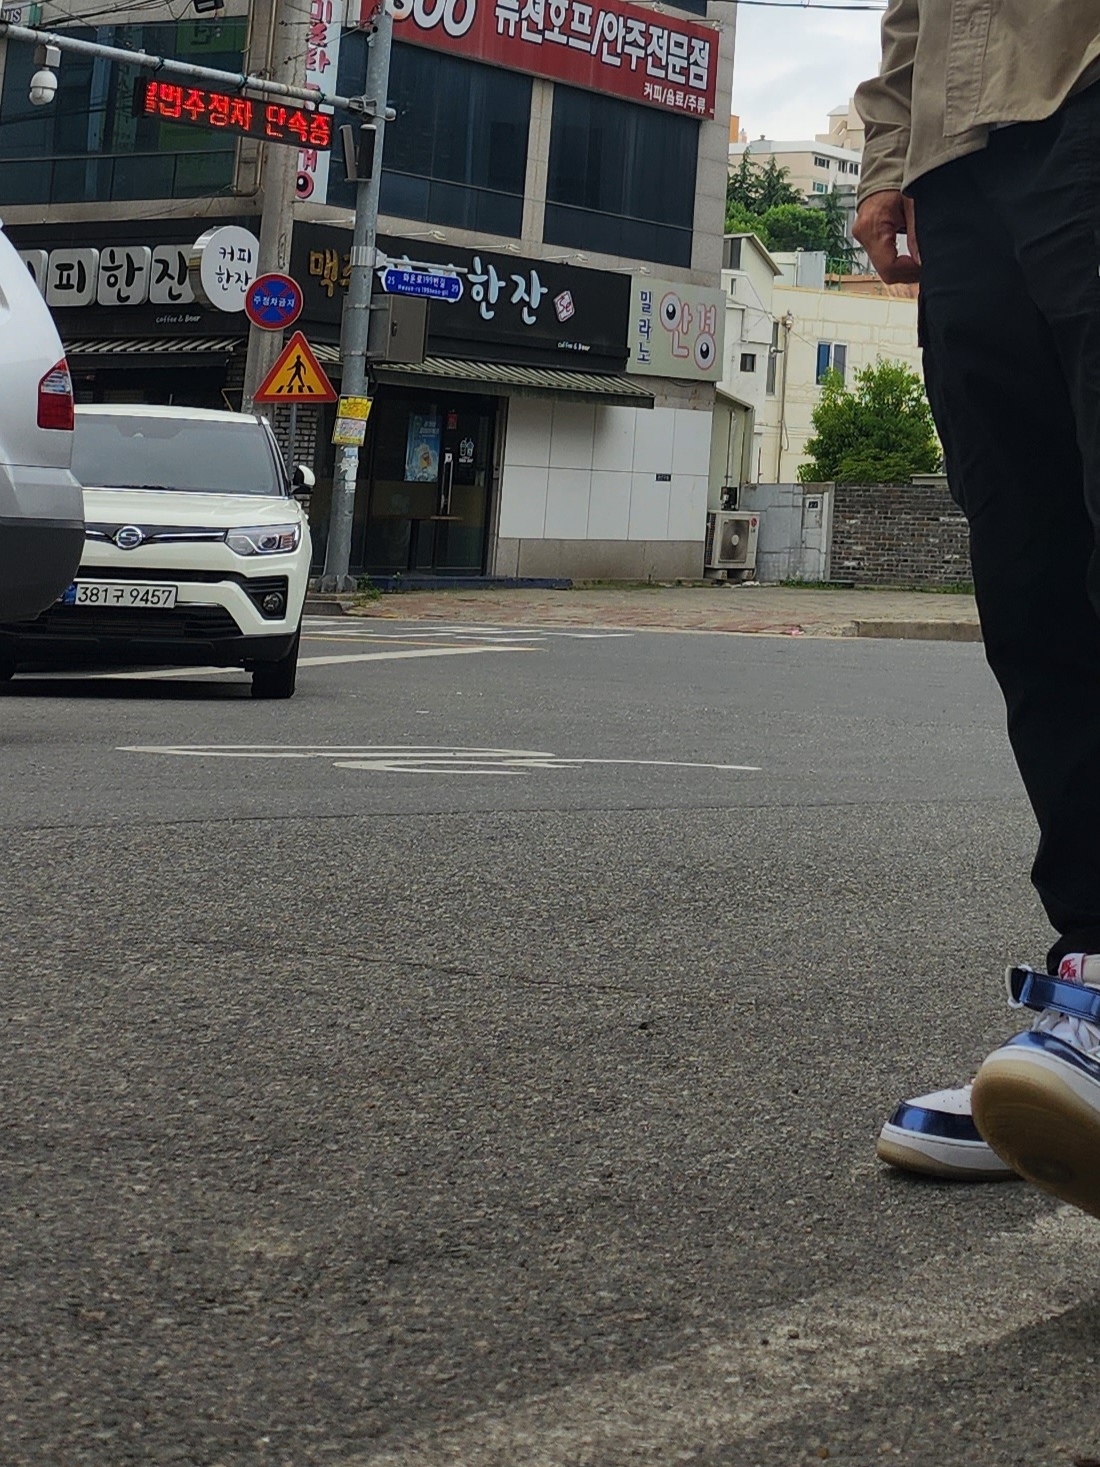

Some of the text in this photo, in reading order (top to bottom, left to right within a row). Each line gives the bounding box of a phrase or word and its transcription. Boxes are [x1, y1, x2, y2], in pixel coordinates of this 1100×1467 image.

[643, 81, 706, 114] 커피/음료/주류
[265, 105, 331, 147] 단속중
[219, 245, 252, 264] 커피
[215, 265, 253, 293] 한잔
[253, 295, 296, 308] 주정차금지
[637, 290, 652, 364] 밀라노
[659, 291, 717, 371] 안경
[77, 586, 173, 606] 381구 9457
